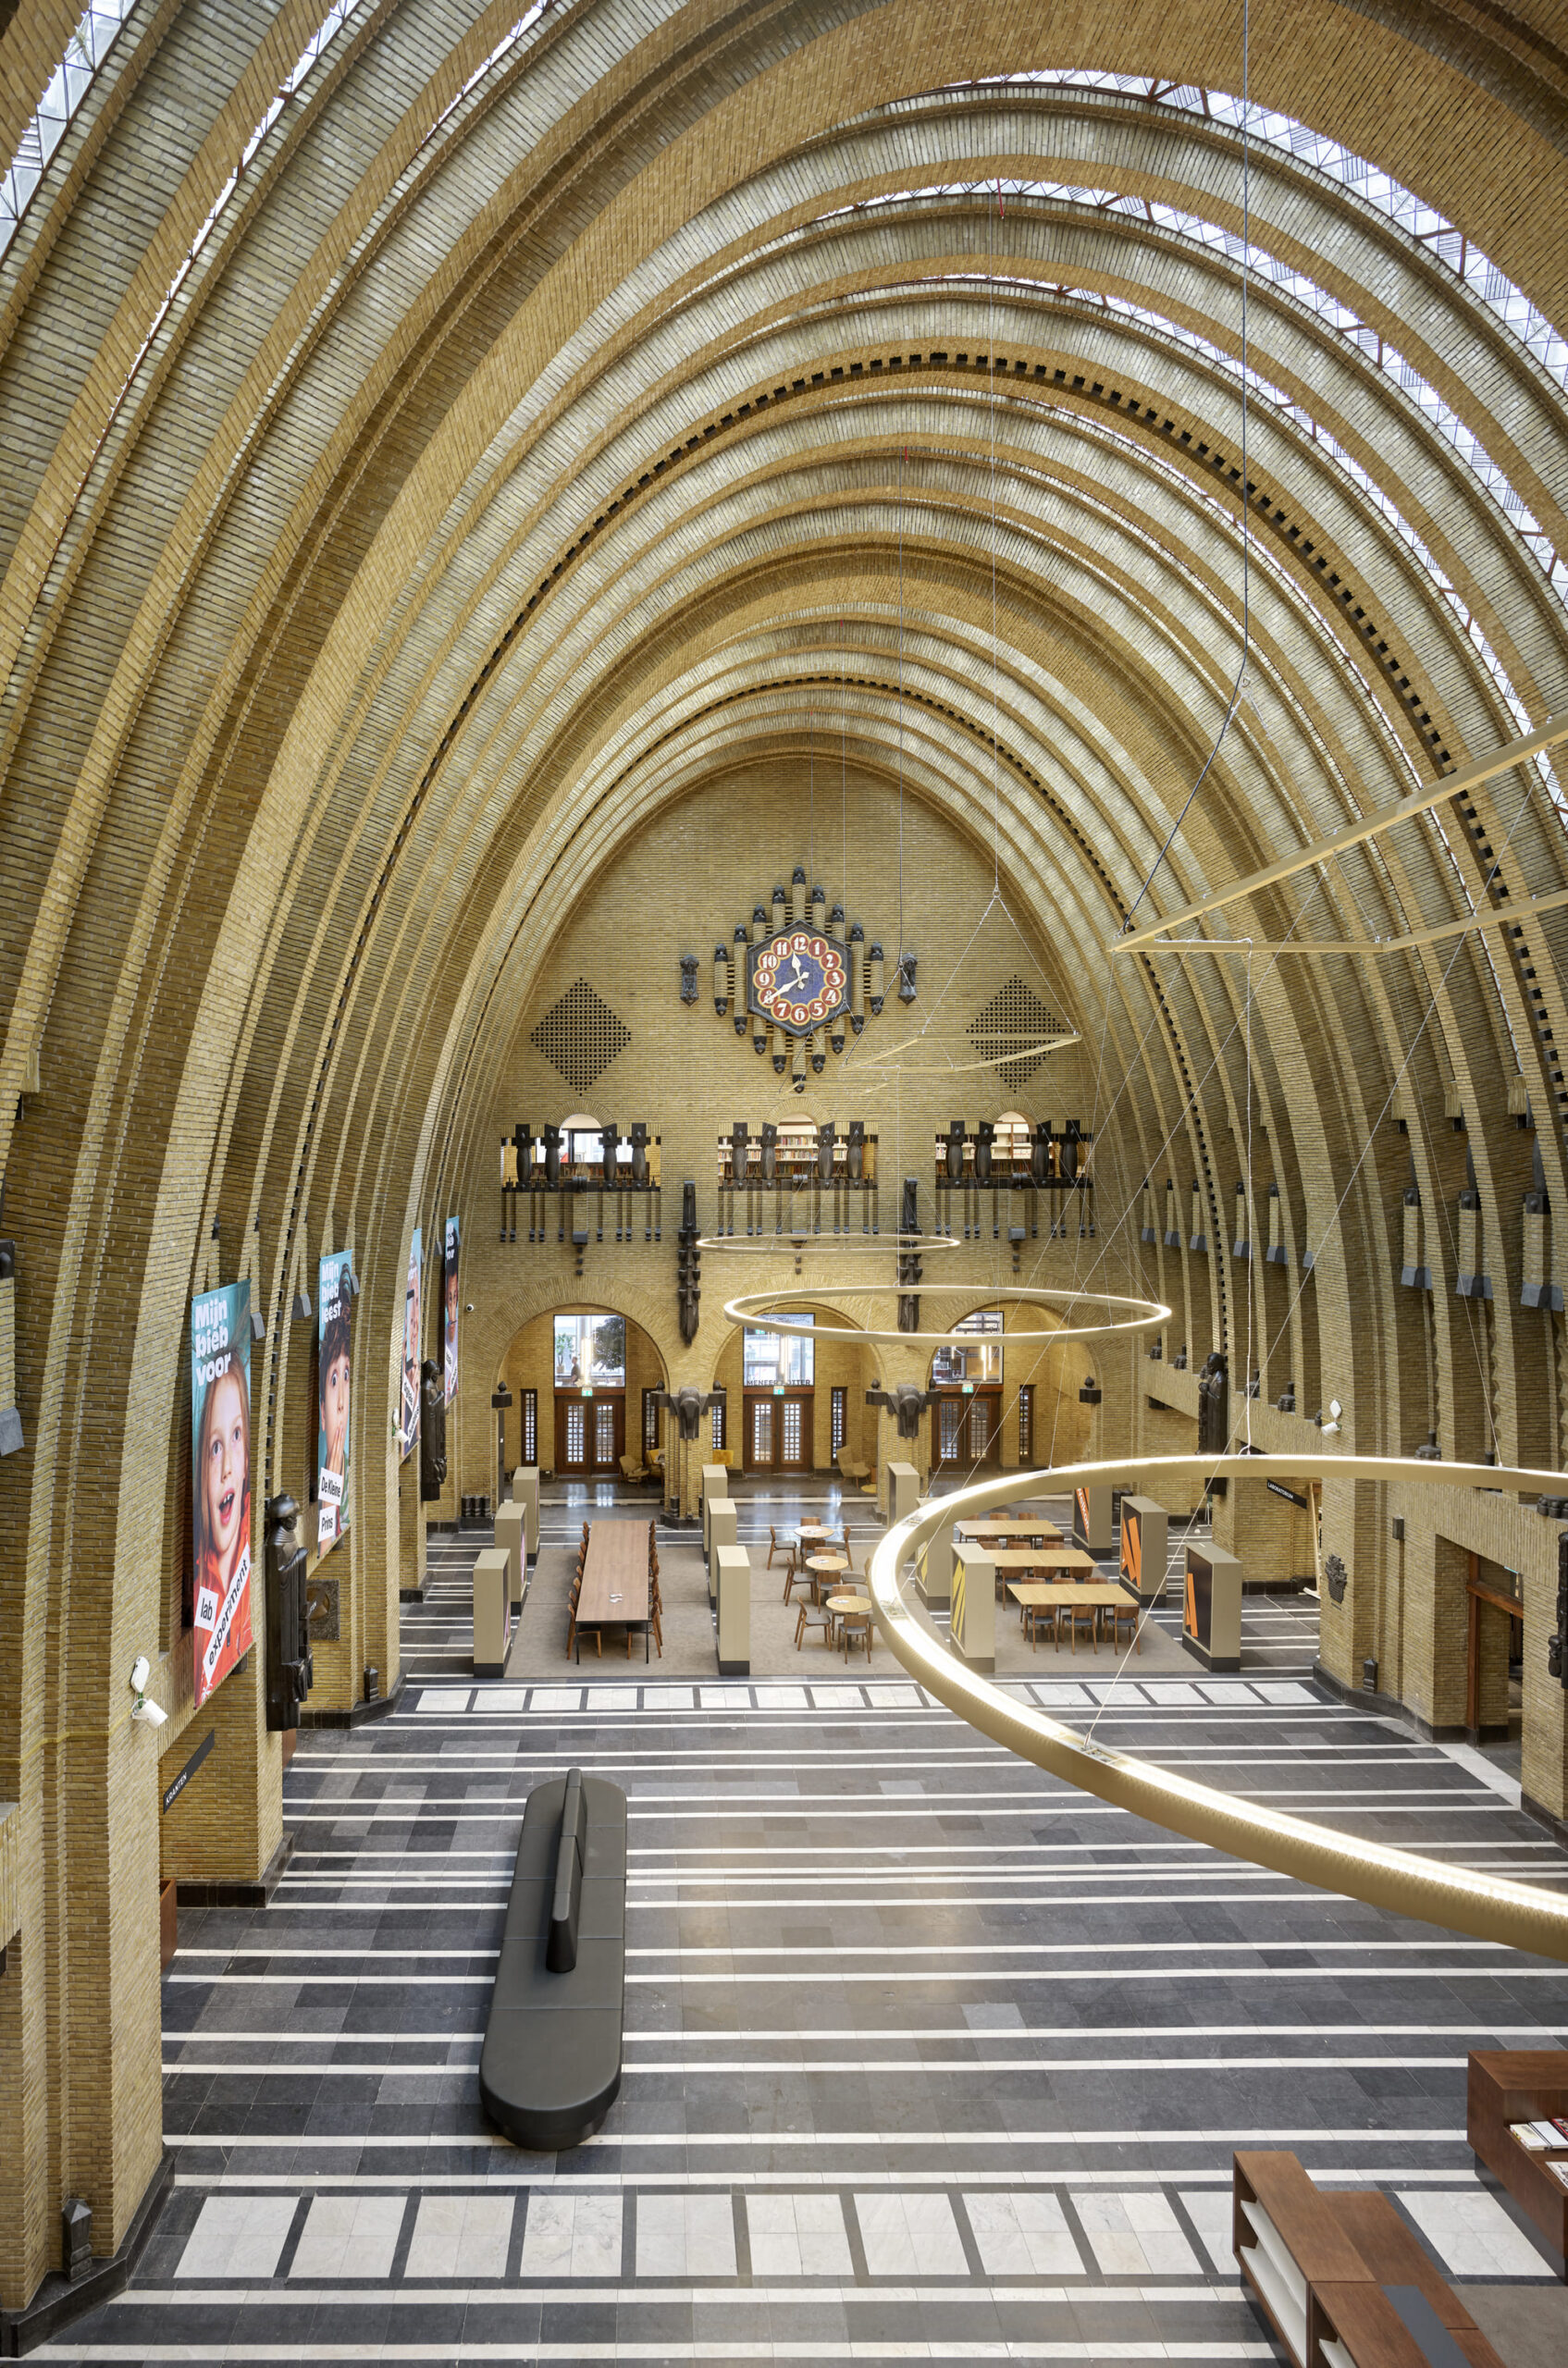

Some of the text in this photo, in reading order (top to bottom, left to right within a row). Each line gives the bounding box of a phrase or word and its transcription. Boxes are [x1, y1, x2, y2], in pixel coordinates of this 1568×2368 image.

[776, 942, 787, 956] 11
[794, 936, 807, 950] 12
[814, 942, 820, 955] 1
[761, 955, 778, 968] 10
[826, 954, 834, 968] 2
[759, 972, 770, 986] 9
[829, 971, 840, 985] 3
[763, 990, 775, 1004] 8
[825, 989, 837, 1004] 4
[777, 1003, 787, 1017] 7
[794, 1007, 806, 1021] 6
[811, 1002, 823, 1016] 5
[322, 1261, 340, 1287] Mijn
[322, 1282, 340, 1302] bieb
[195, 1298, 228, 1330] Mijn
[321, 1300, 342, 1325] leest
[195, 1325, 228, 1359] bieb
[195, 1351, 231, 1387] voor
[321, 1476, 341, 1497] De Kleine
[321, 1515, 333, 1532] Prins
[201, 1597, 213, 1622] lab
[209, 1558, 248, 1666] experiment
[167, 1771, 187, 1806] KRANTEN
